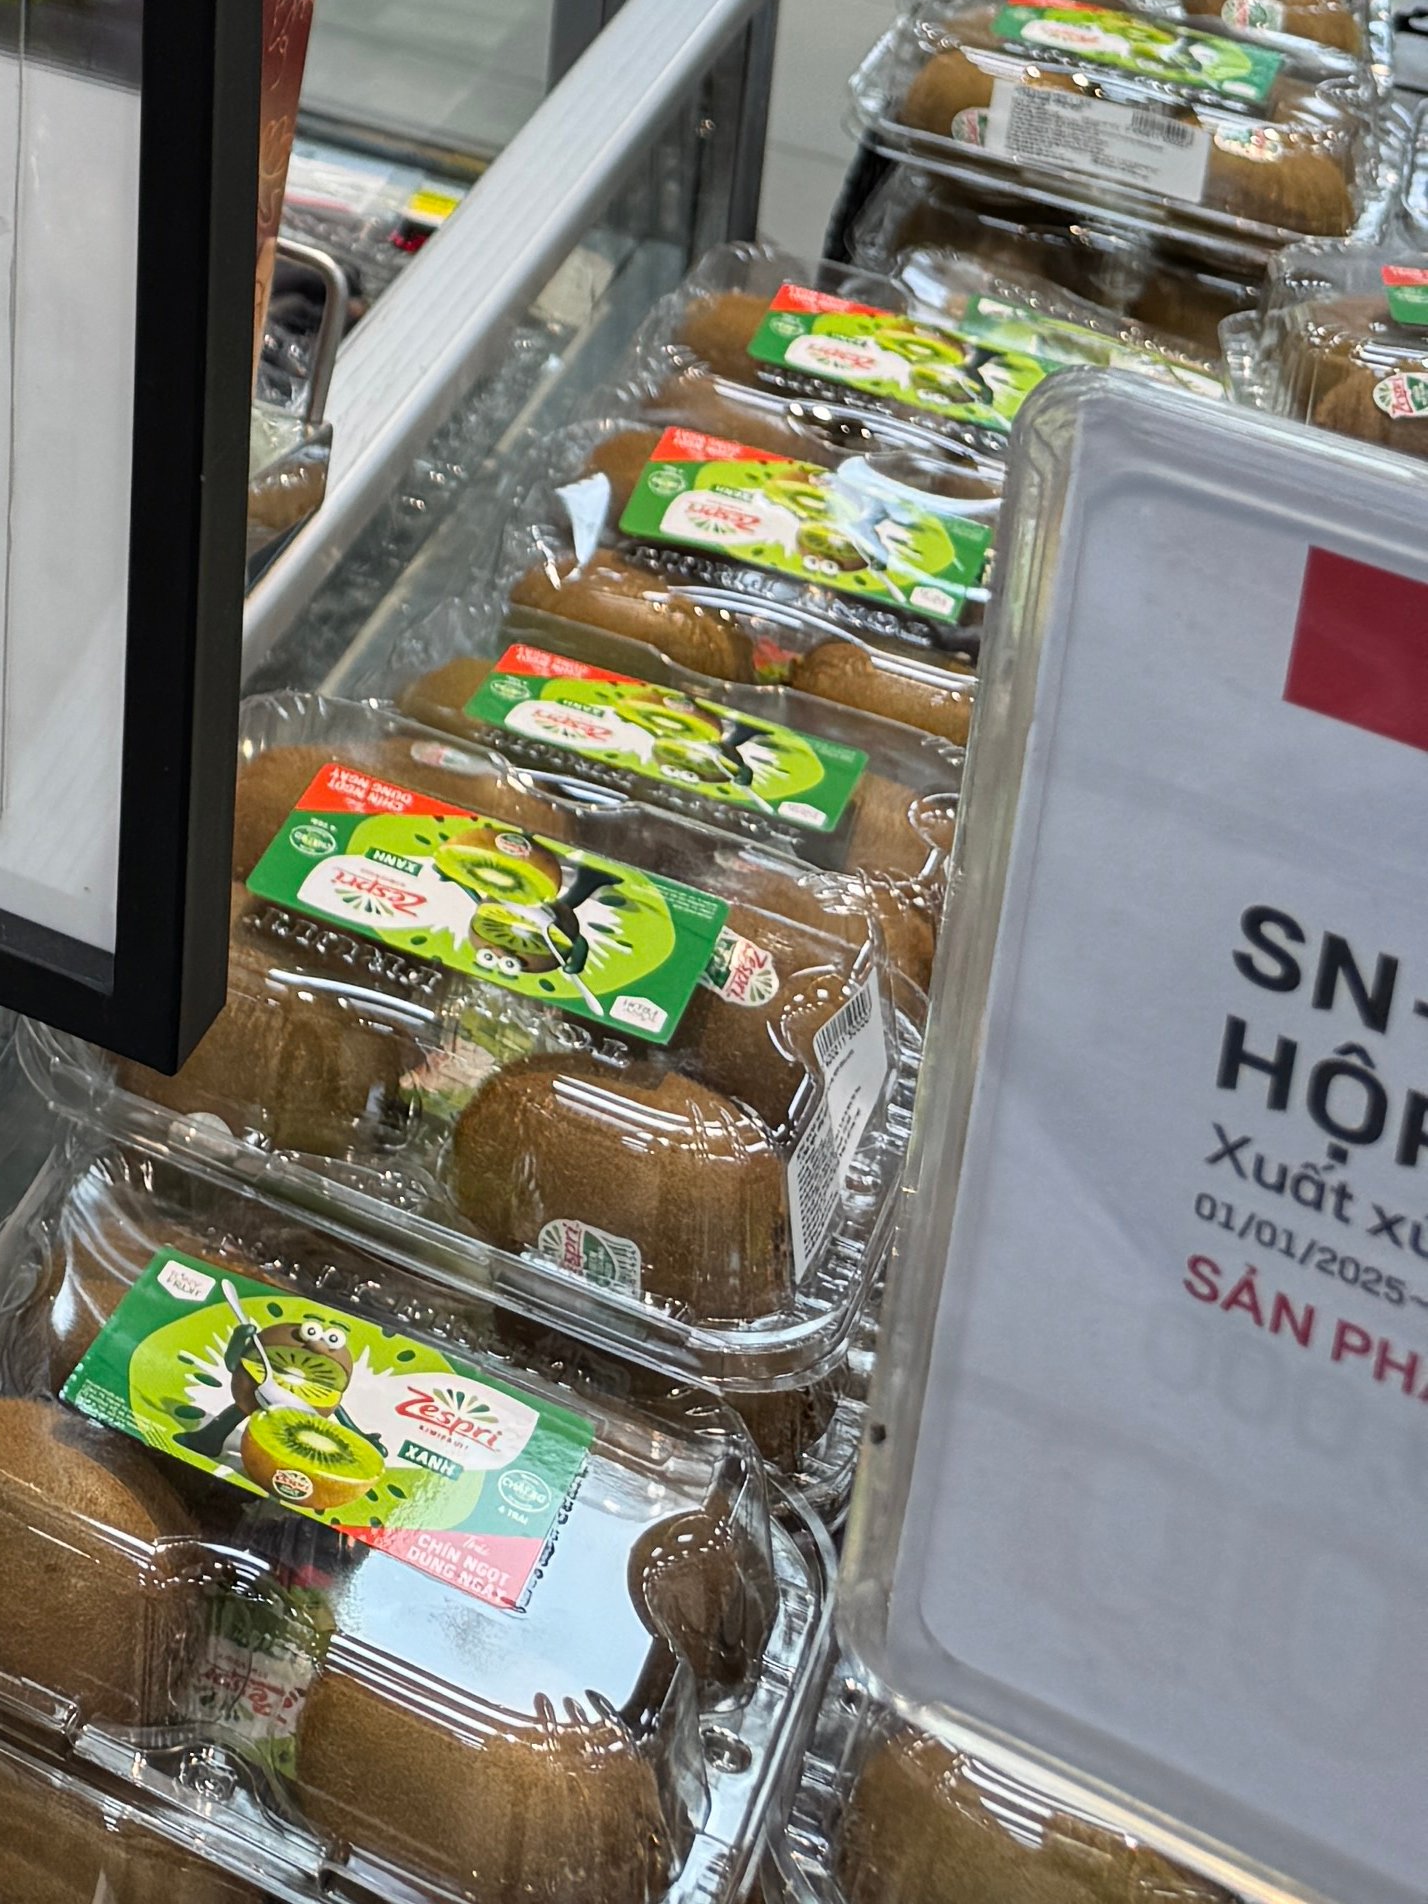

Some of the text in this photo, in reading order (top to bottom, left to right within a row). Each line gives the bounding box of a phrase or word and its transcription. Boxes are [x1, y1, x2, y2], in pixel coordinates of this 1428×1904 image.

[329, 868, 428, 922] Zespri
[1204, 1121, 1354, 1225] Xuất
[1183, 1254, 1428, 1403] SẢN PH
[394, 1385, 503, 1449] Zespri
[404, 1444, 457, 1477] XANH
[417, 1534, 462, 1563] CHÍN
